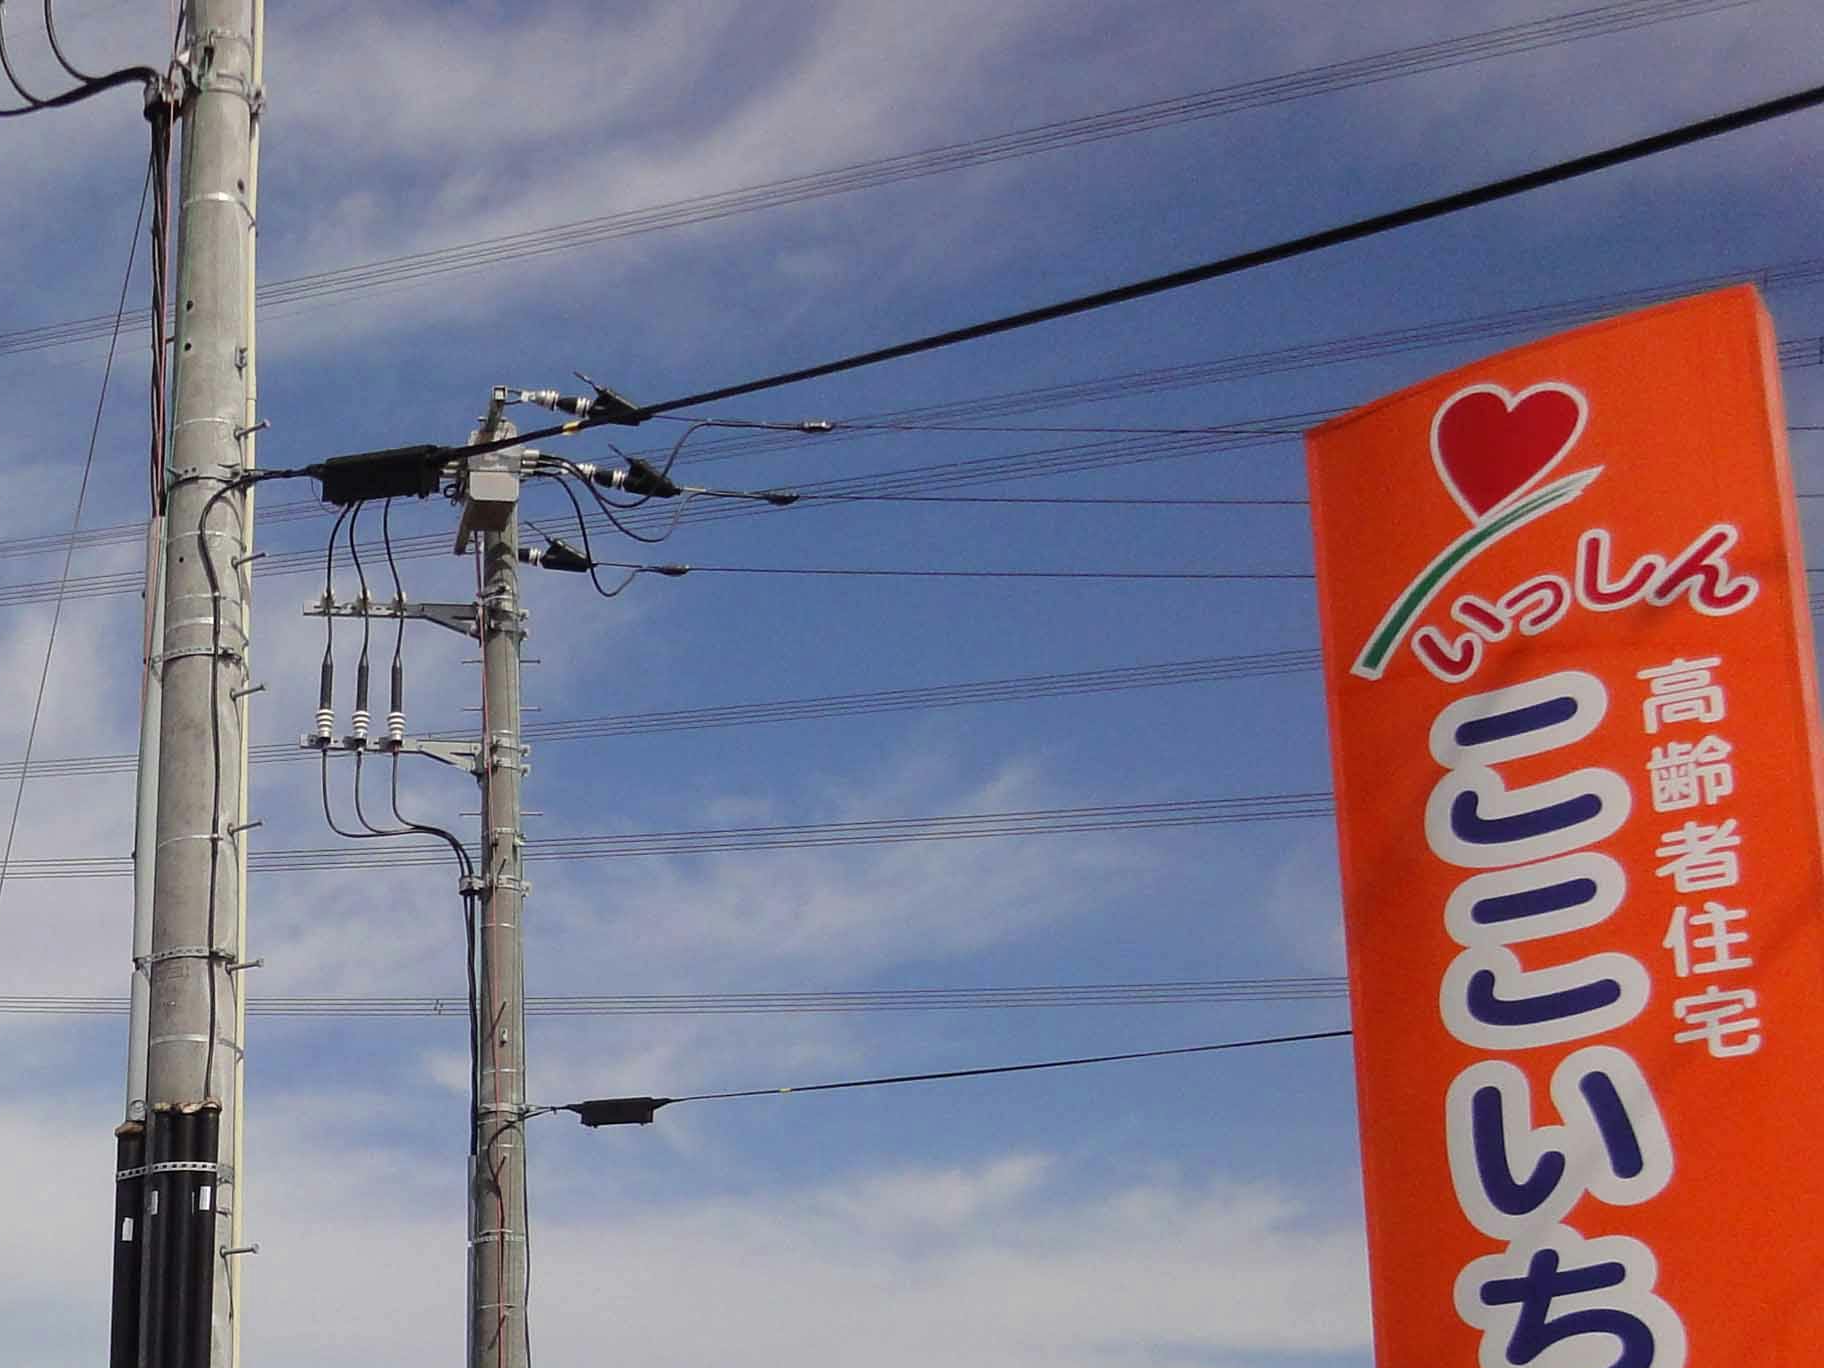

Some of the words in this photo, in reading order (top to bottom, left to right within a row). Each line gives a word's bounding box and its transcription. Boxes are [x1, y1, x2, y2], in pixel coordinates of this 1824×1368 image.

[1411, 524, 1759, 684] いっしん
[1636, 656, 1762, 1059] 高齢者住宅
